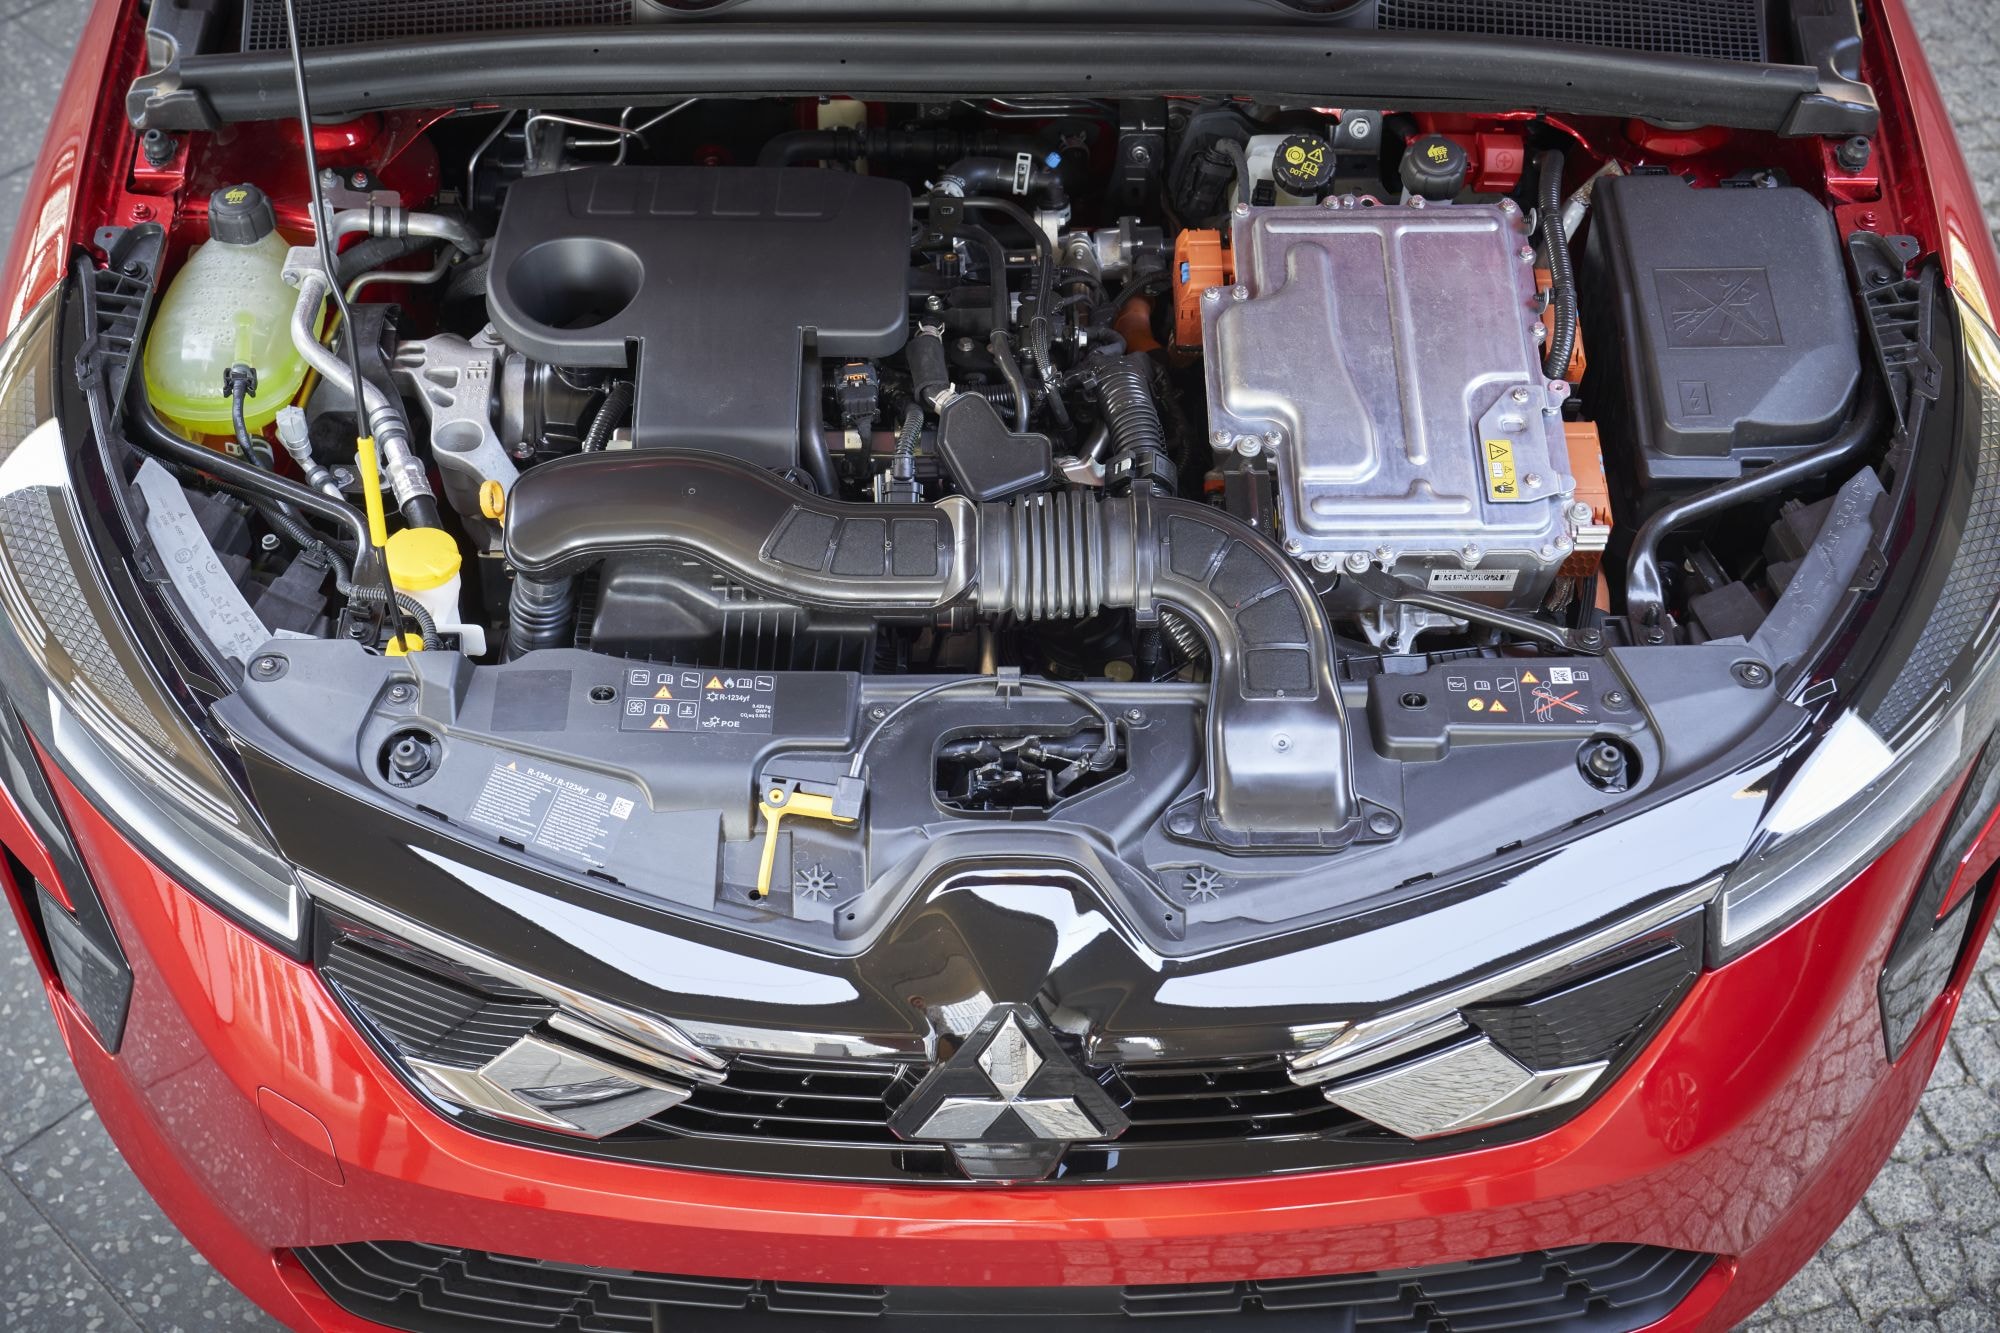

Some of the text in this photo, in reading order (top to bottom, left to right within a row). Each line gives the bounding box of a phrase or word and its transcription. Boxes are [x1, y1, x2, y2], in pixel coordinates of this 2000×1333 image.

[1289, 167, 1303, 177] DOT
[719, 693, 750, 703] R-1234yf
[721, 720, 740, 728] POE
[526, 768, 552, 782] R-134a
[557, 778, 589, 794] R-1234yf
